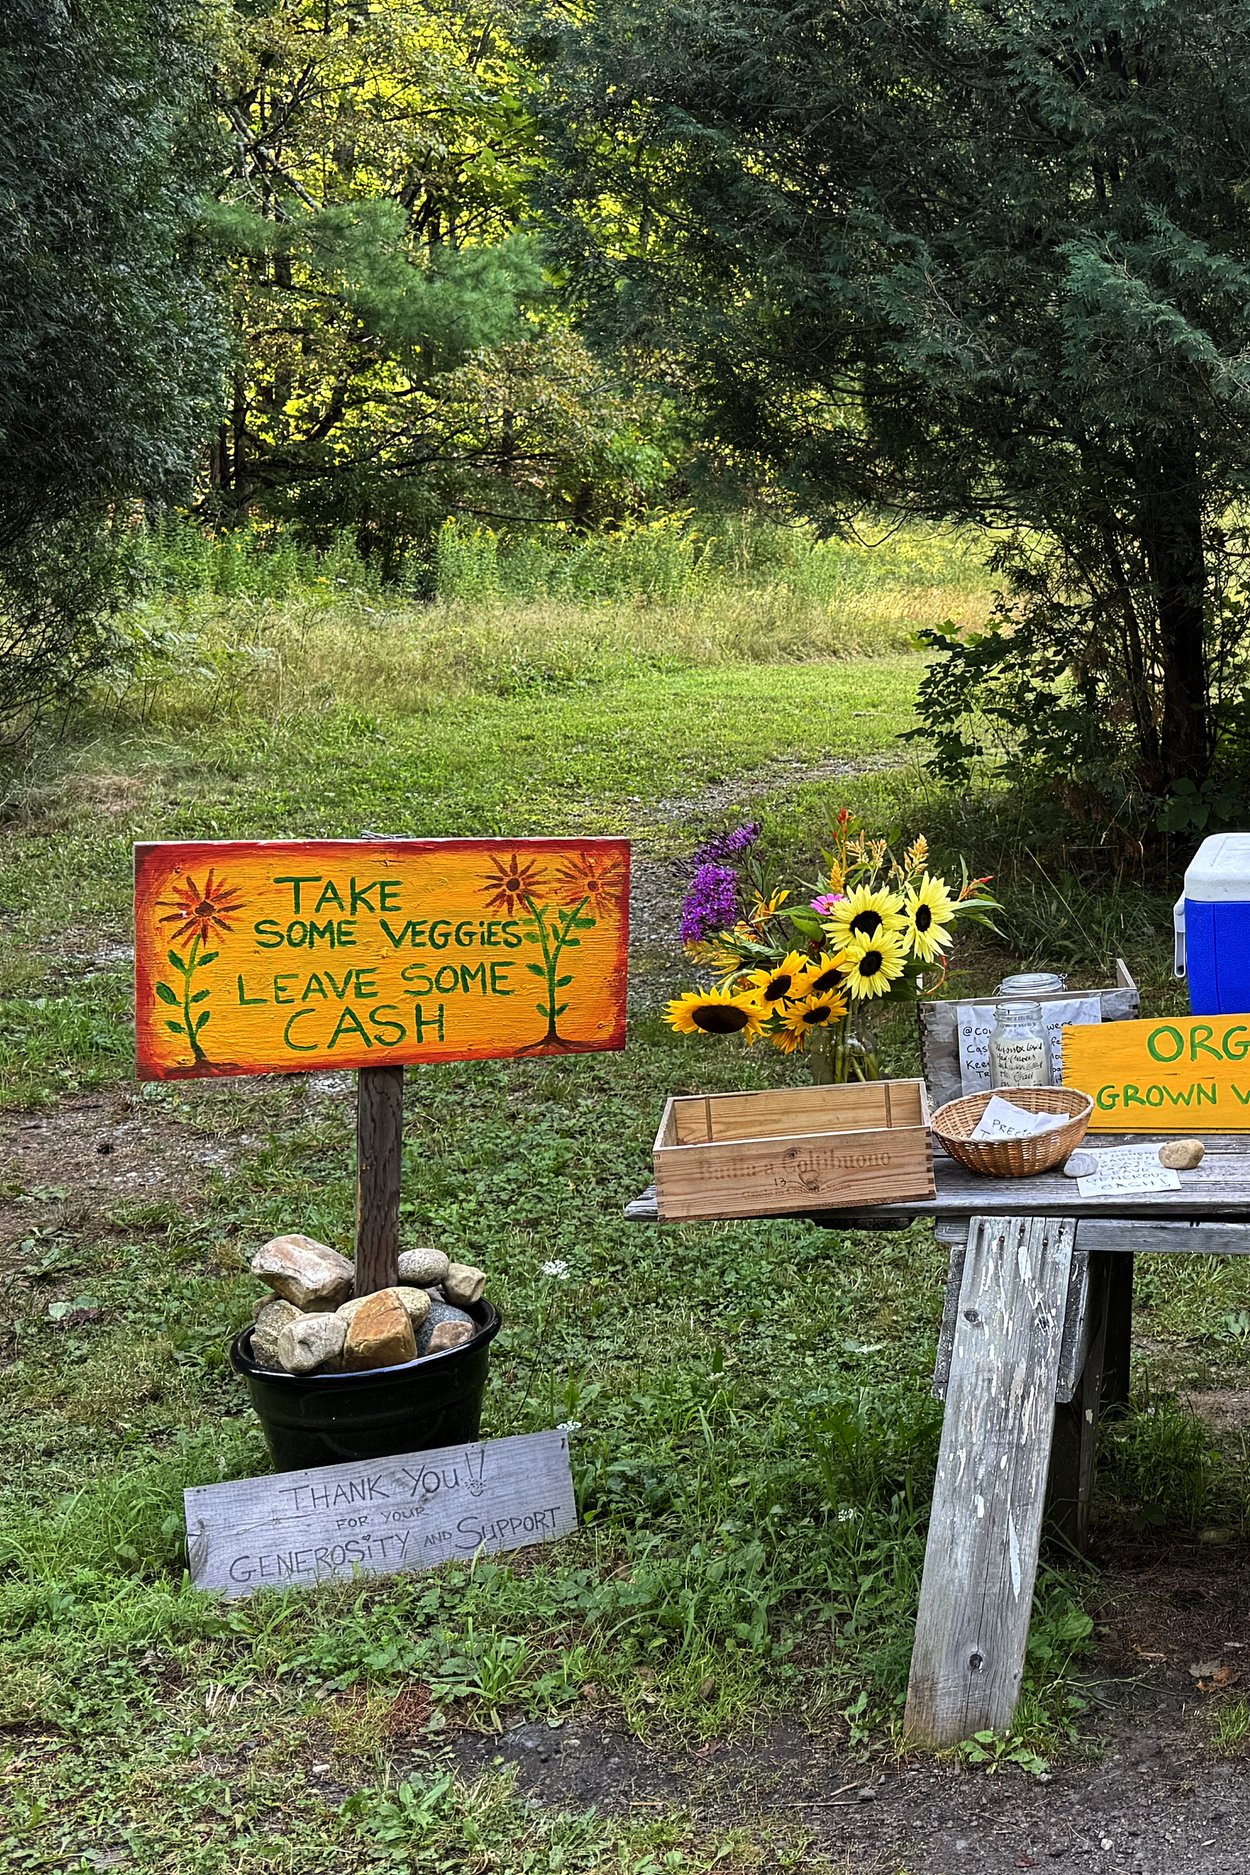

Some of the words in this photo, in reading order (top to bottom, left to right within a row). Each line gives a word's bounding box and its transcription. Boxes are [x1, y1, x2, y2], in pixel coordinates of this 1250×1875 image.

[273, 876, 404, 916] TAKE
[254, 918, 358, 949] SOME
[238, 967, 380, 1006] LEAVE
[402, 961, 516, 997] SOME
[283, 1003, 445, 1051] CASH
[1096, 1081, 1218, 1111] GROWN
[279, 1474, 391, 1512] THANK
[336, 1515, 370, 1530] FOR
[381, 1505, 430, 1523] YOUR
[423, 1530, 453, 1549] AND
